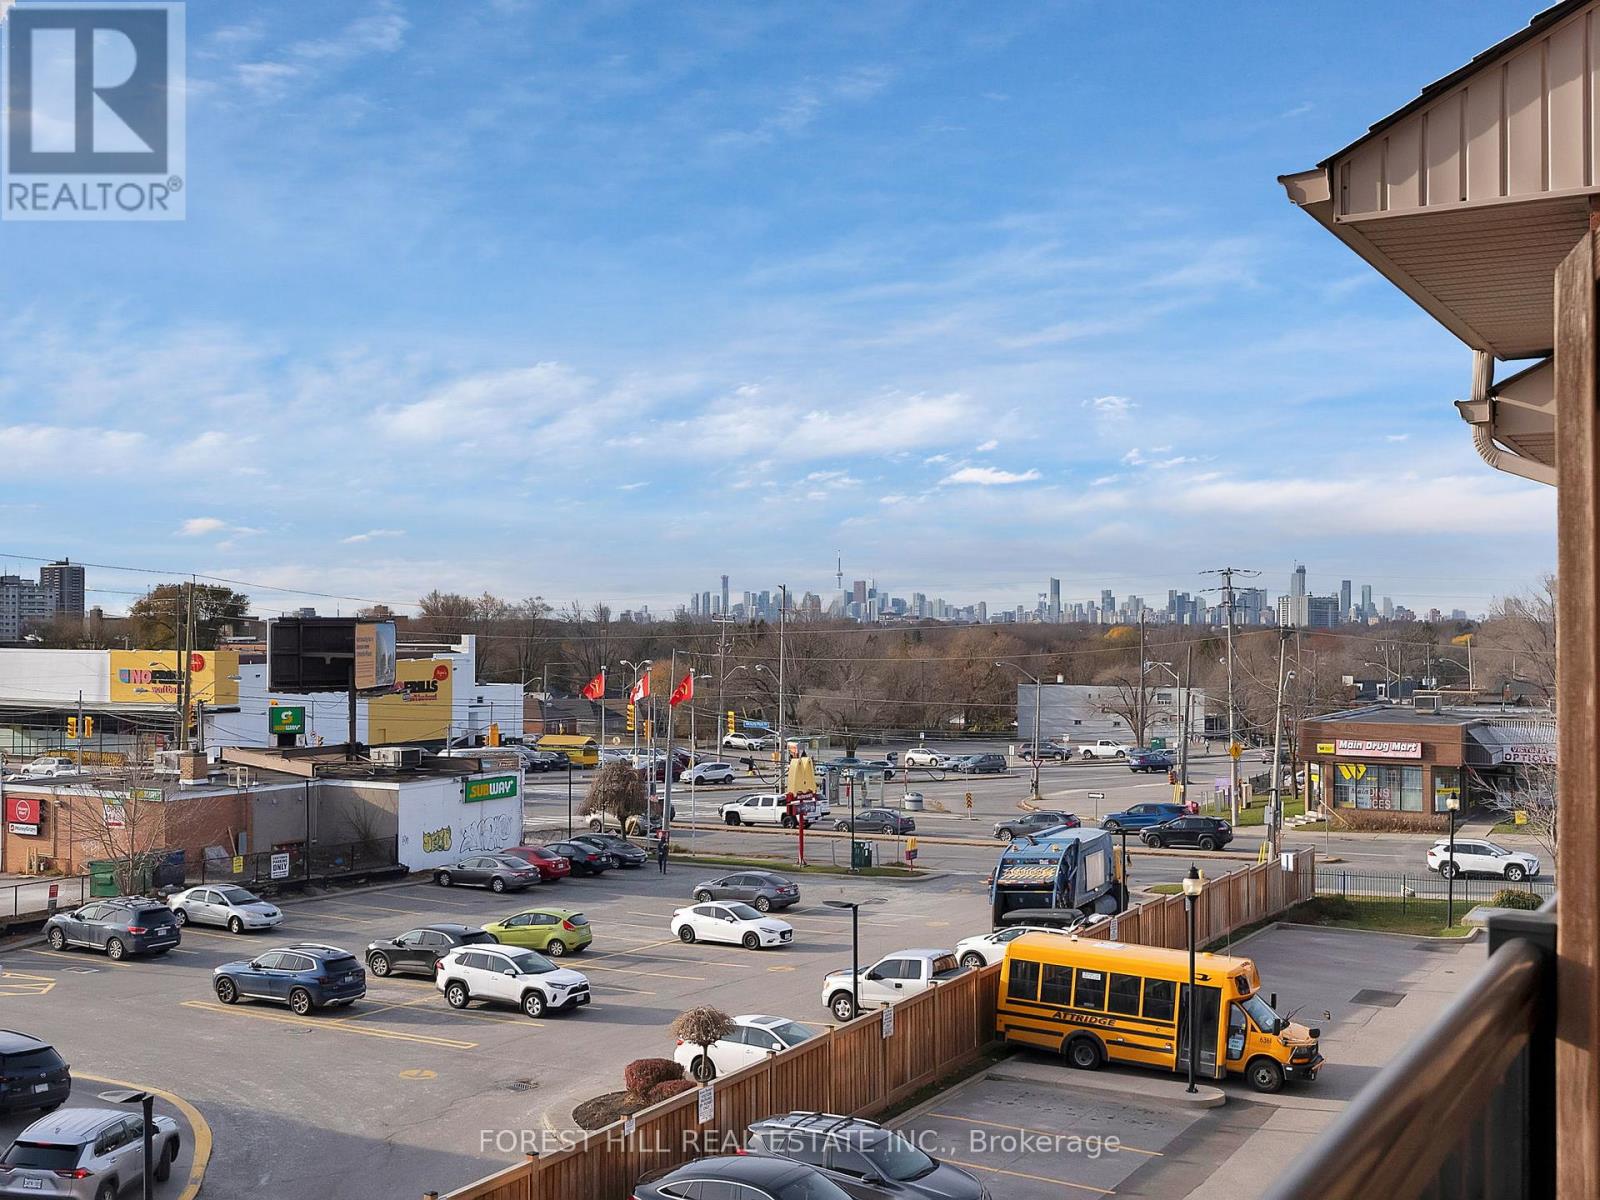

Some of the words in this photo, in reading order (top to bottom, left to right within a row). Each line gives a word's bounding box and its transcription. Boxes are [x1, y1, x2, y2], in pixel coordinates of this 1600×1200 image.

[1338, 740, 1363, 750] Main
[1366, 742, 1389, 754] Drug
[1391, 743, 1418, 753] Mart
[469, 780, 514, 798] SUBWAY
[272, 862, 287, 871] ONLY
[1052, 1011, 1117, 1027] ATTRIDGE
